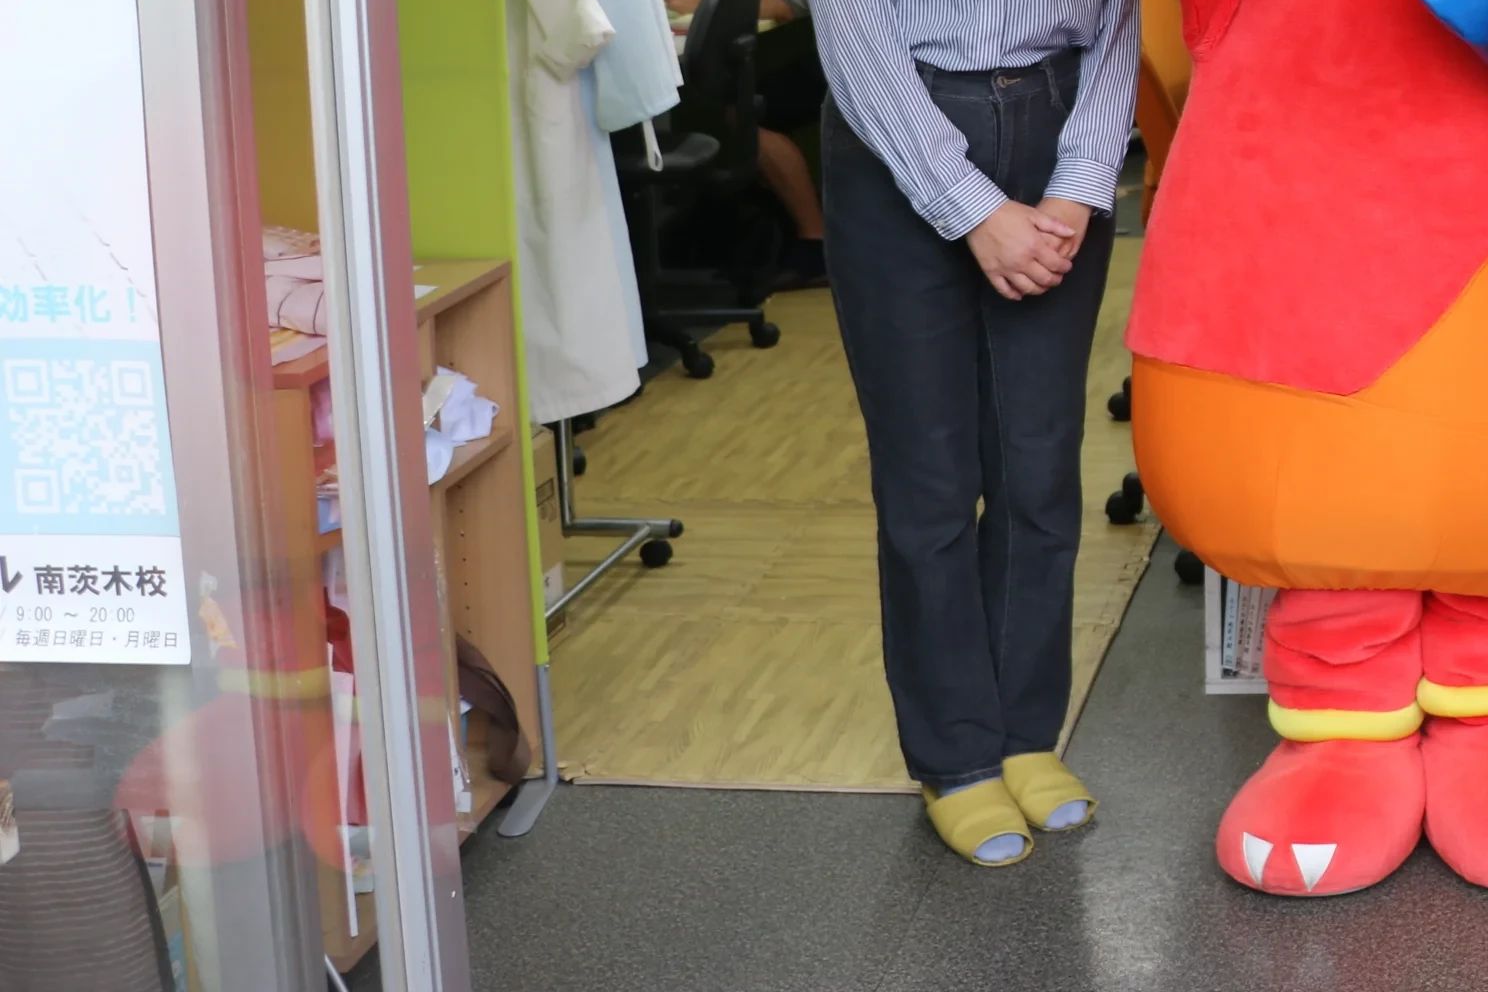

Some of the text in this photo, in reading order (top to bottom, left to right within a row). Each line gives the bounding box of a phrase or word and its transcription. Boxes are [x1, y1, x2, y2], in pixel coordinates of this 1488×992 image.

[33, 564, 168, 597] 南茨木校
[15, 628, 178, 649] 毎週日曜日・月曜日
